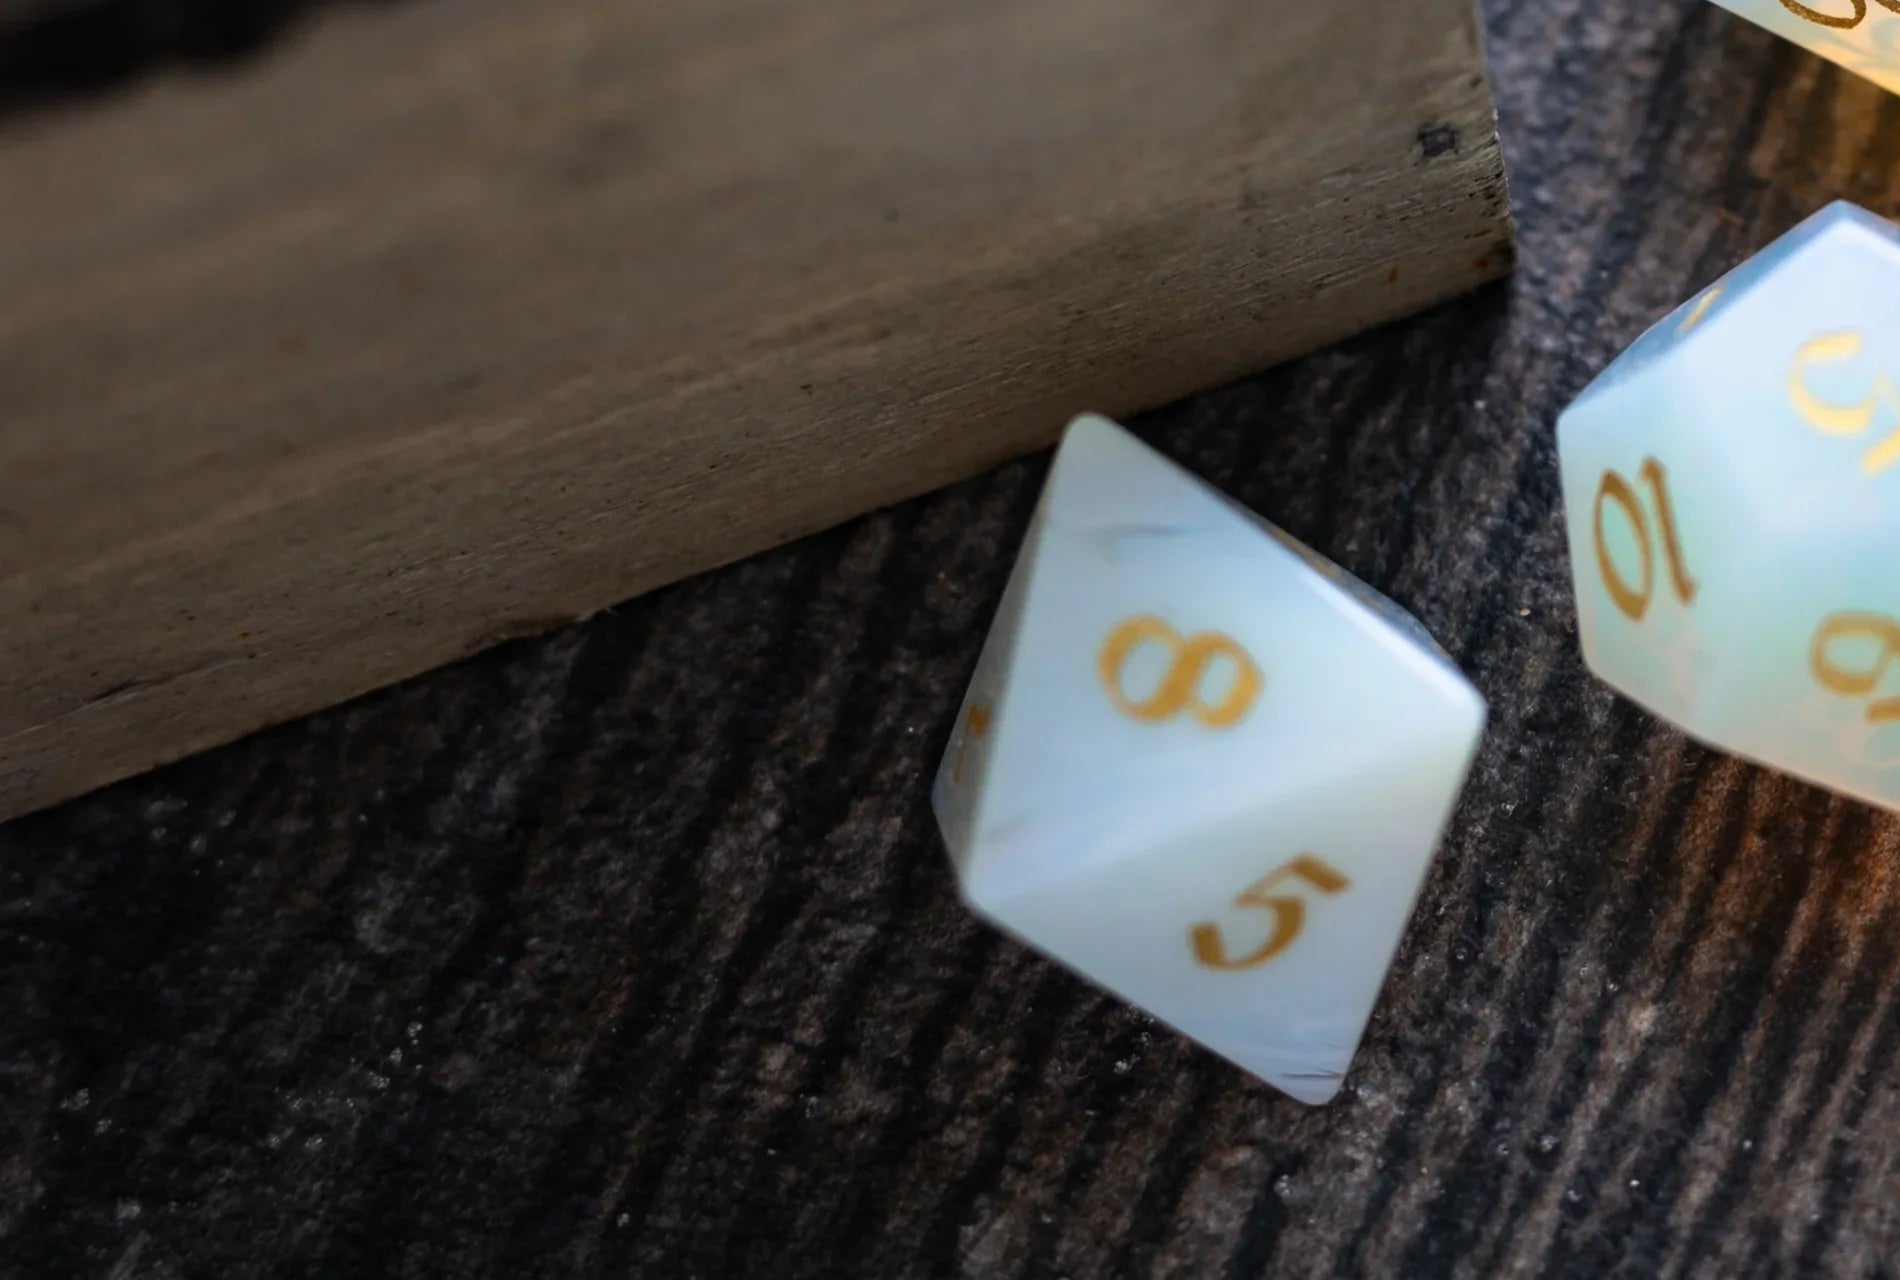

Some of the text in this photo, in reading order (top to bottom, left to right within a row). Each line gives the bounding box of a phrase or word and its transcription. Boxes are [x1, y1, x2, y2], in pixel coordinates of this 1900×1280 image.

[1593, 457, 1695, 622] 10
[1098, 614, 1264, 730] 8
[1189, 853, 1352, 971] 5
